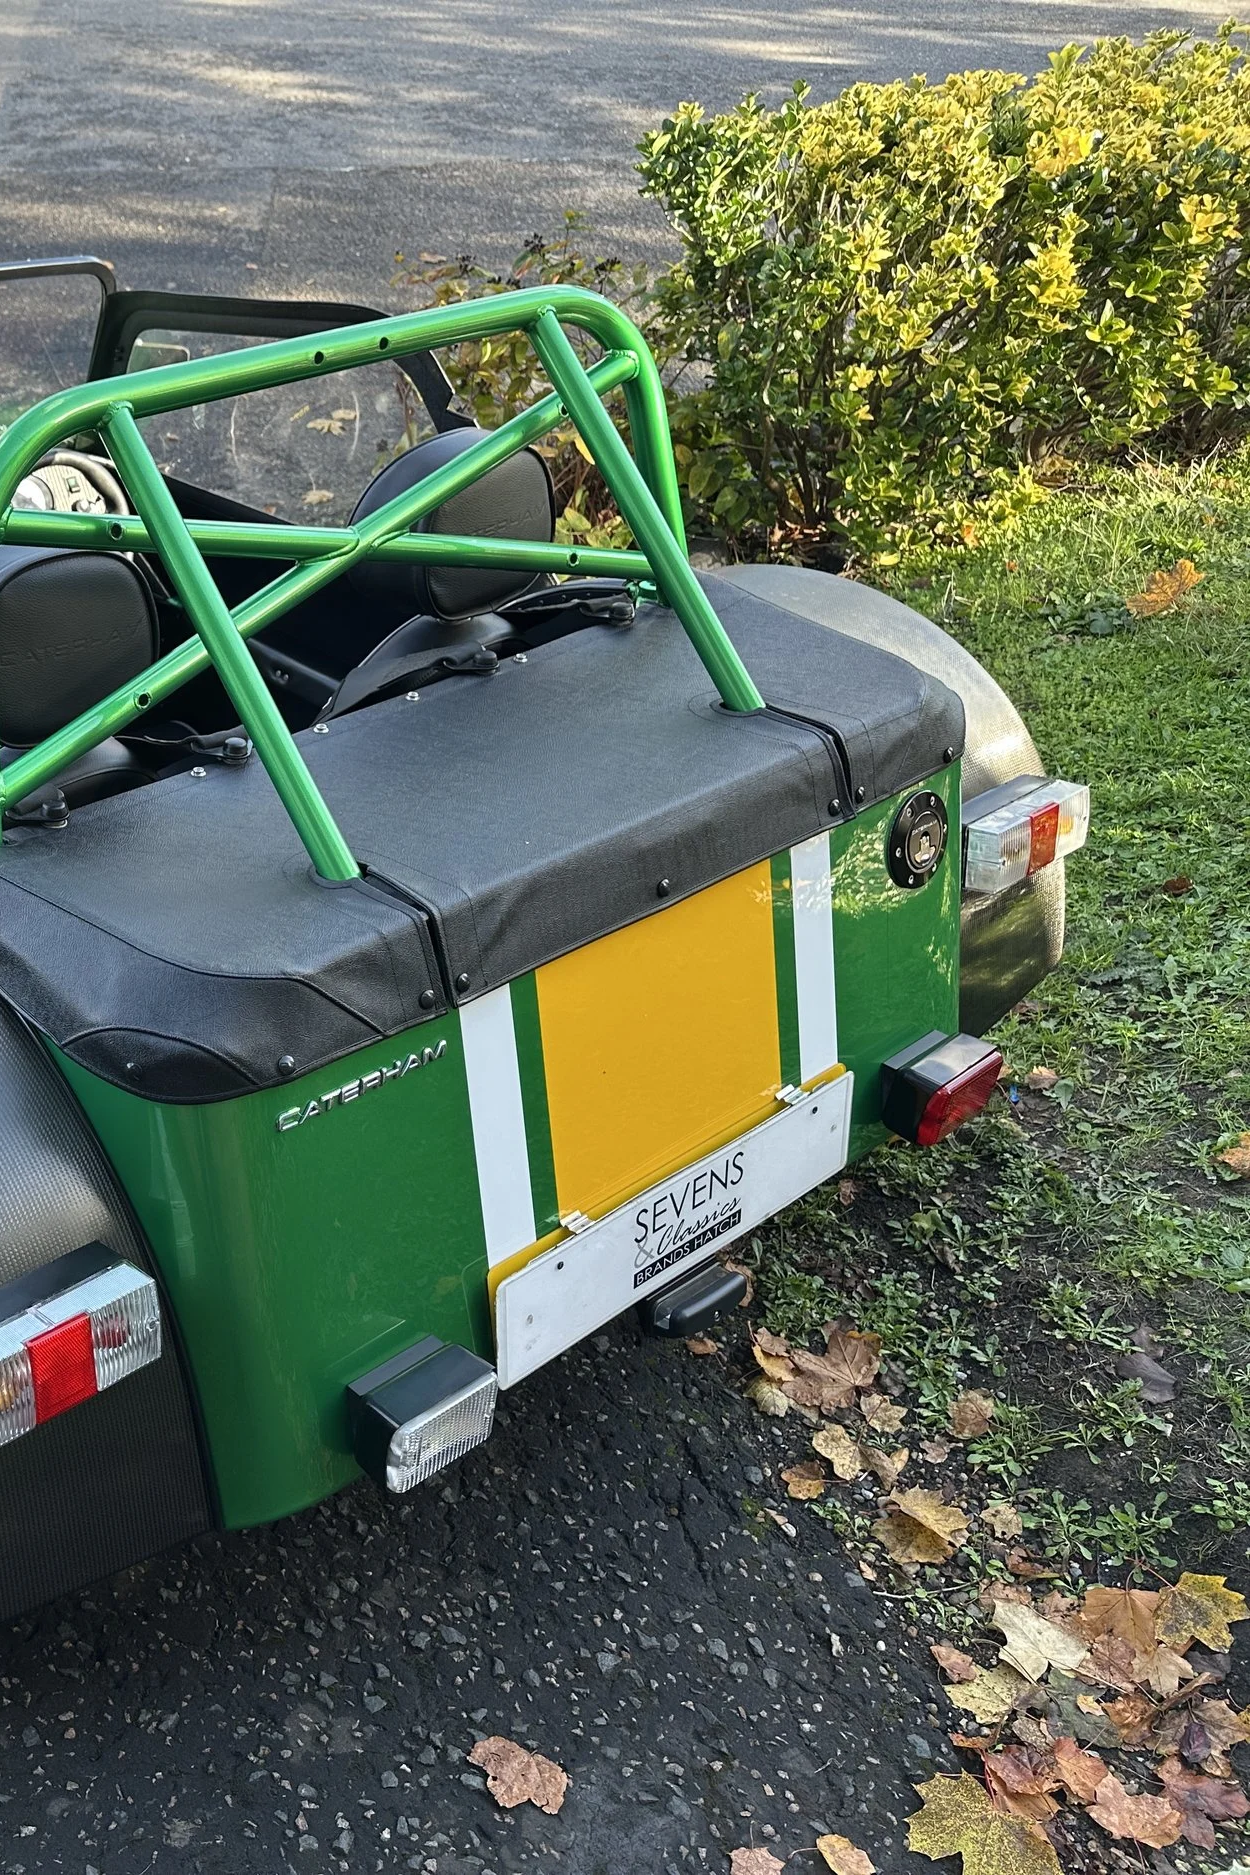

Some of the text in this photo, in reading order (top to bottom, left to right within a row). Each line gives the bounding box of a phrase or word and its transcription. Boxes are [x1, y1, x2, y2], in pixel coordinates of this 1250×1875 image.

[276, 1039, 447, 1132] CATERHAM
[634, 1151, 744, 1244] SEVENS
[634, 1197, 742, 1269] & Classics
[636, 1211, 740, 1287] BRANDS HATCH
